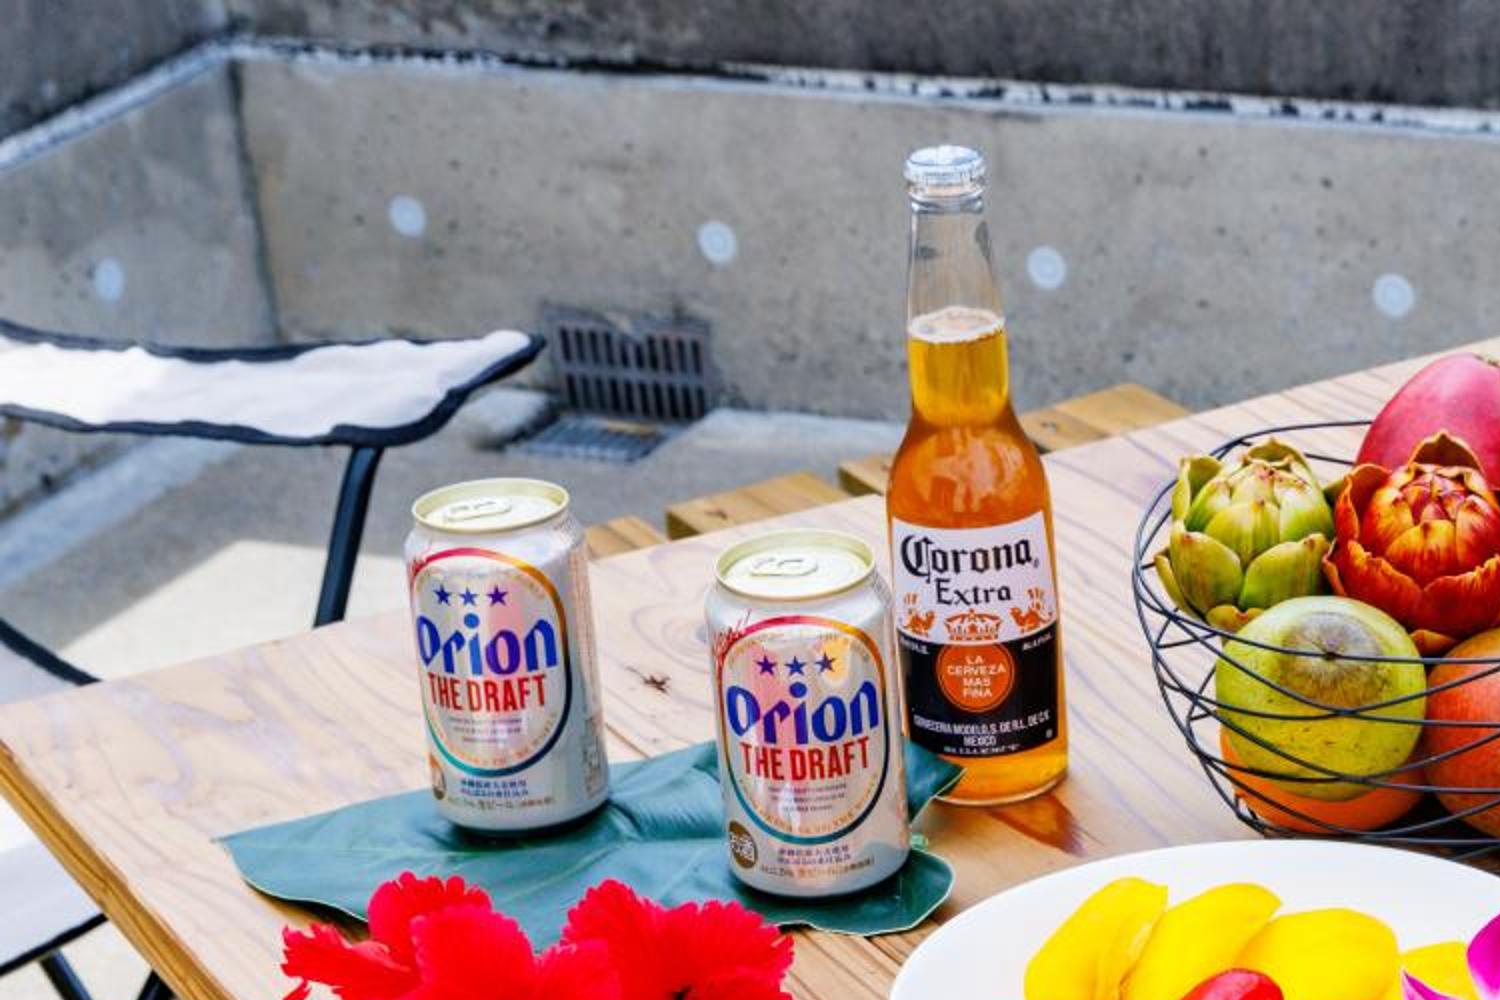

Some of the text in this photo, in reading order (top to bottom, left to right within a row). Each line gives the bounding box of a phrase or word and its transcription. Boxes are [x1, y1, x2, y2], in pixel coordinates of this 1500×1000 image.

[901, 534, 1033, 583] Corona
[934, 577, 1012, 606] Extra
[416, 612, 559, 676] Orion
[965, 655, 984, 665] LA
[947, 664, 1007, 676] CERVEZA
[963, 677, 992, 687] MAS
[428, 671, 546, 713] THE DRAFT
[963, 688, 993, 698] FINA
[726, 680, 880, 745] Orion
[740, 736, 870, 781] THE DRAFT
